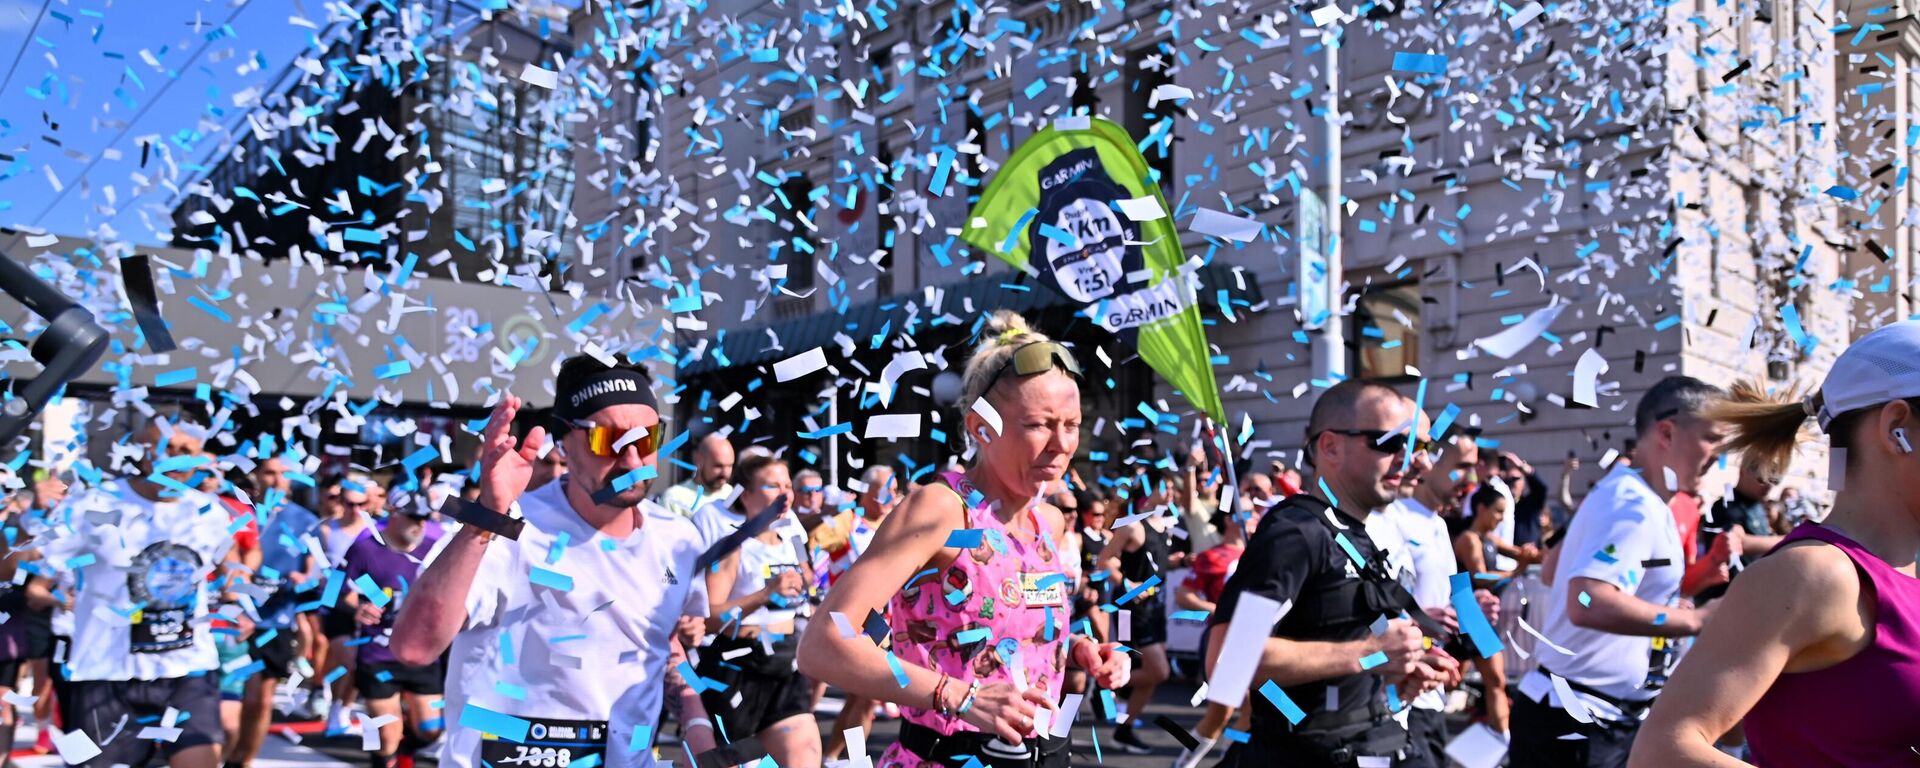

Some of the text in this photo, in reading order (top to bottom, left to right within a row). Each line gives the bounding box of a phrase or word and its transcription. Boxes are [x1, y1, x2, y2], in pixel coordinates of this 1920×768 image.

[1041, 159, 1093, 190] GARMIN
[1074, 269, 1112, 294] 1:51
[446, 307, 479, 334] 20
[1109, 299, 1178, 327] GARMIN
[445, 335, 479, 363] 26
[571, 378, 637, 407] RUNNING
